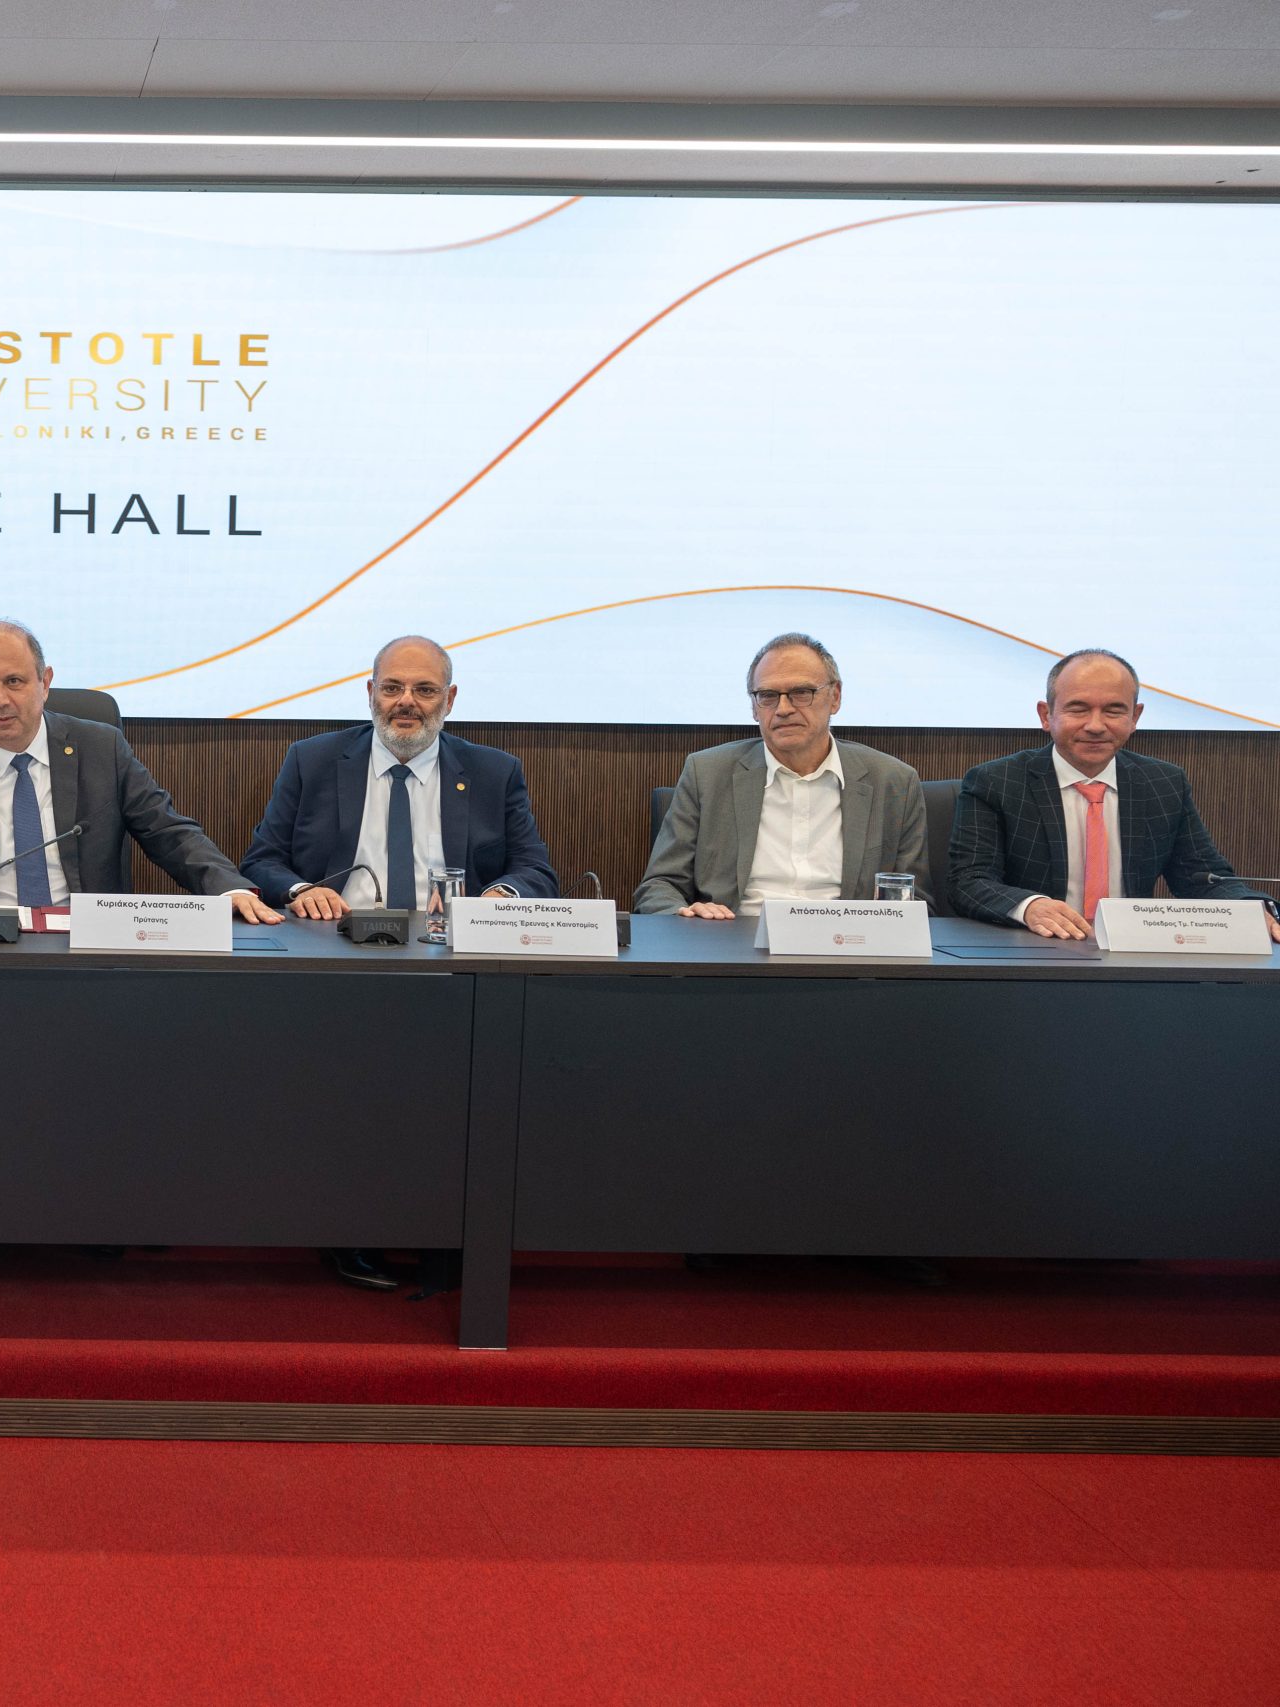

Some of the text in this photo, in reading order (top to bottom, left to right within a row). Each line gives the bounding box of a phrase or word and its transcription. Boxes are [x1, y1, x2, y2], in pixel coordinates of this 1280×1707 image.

[53, 493, 262, 536] HALL
[96, 899, 206, 912] Κυριάκος Αναστασιάδης
[494, 903, 573, 915] Ιωάννης Ρέκανος
[1132, 904, 1233, 916] Θωμάς Κωτσόπουλος
[789, 906, 904, 918] Απόστολος Αποστολίδης
[133, 916, 169, 925] Πρύτανης
[361, 921, 401, 932] TAIDEN
[469, 918, 518, 928] Αντιπρύτανης
[556, 920, 599, 930] Καινοτομίας
[1142, 919, 1178, 928] Πρόεδρος
[1189, 920, 1229, 929] Γεωπονίας
